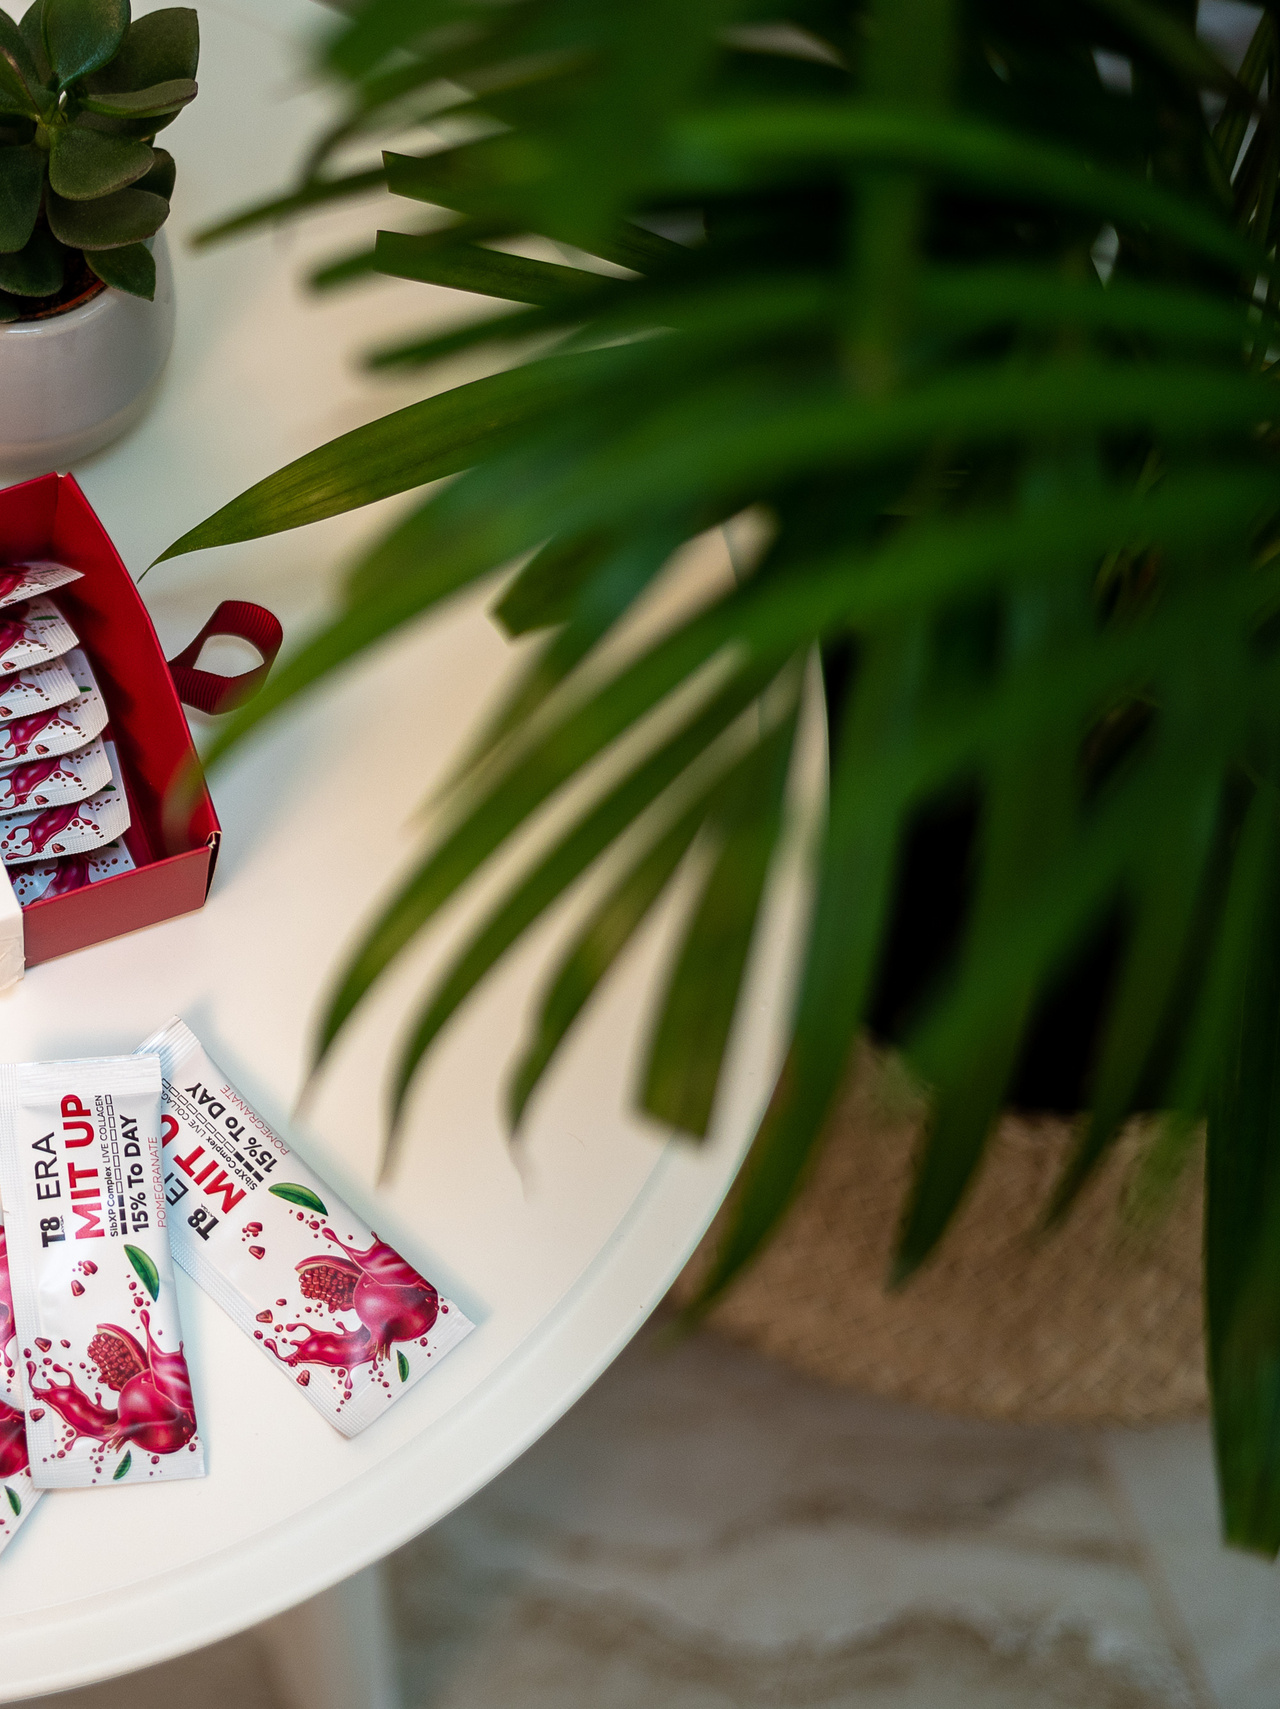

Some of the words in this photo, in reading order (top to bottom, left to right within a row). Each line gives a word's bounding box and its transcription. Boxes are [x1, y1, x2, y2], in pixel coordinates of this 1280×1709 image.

[95, 1095, 107, 1141] COLLAGEN
[161, 1090, 190, 1120] COLLAG
[185, 1082, 226, 1120] DAY
[60, 1094, 95, 1149] UP
[120, 1114, 141, 1157] DAY
[188, 1120, 207, 1137] LIVE
[220, 1085, 290, 1156] POMEGRANATE
[225, 1116, 246, 1142] To
[32, 1131, 61, 1200] ERA
[101, 1143, 110, 1163] LIVE
[206, 1136, 236, 1168] Complex
[244, 1137, 278, 1173] 15%
[104, 1167, 115, 1206] Complex
[127, 1163, 144, 1188] To
[148, 1136, 166, 1228] POMEGRANATE
[173, 1145, 247, 1214] MIT
[234, 1168, 258, 1191] SibXP
[67, 1162, 105, 1240] MIT
[129, 1192, 149, 1232] 15%
[108, 1208, 118, 1237] SibXP
